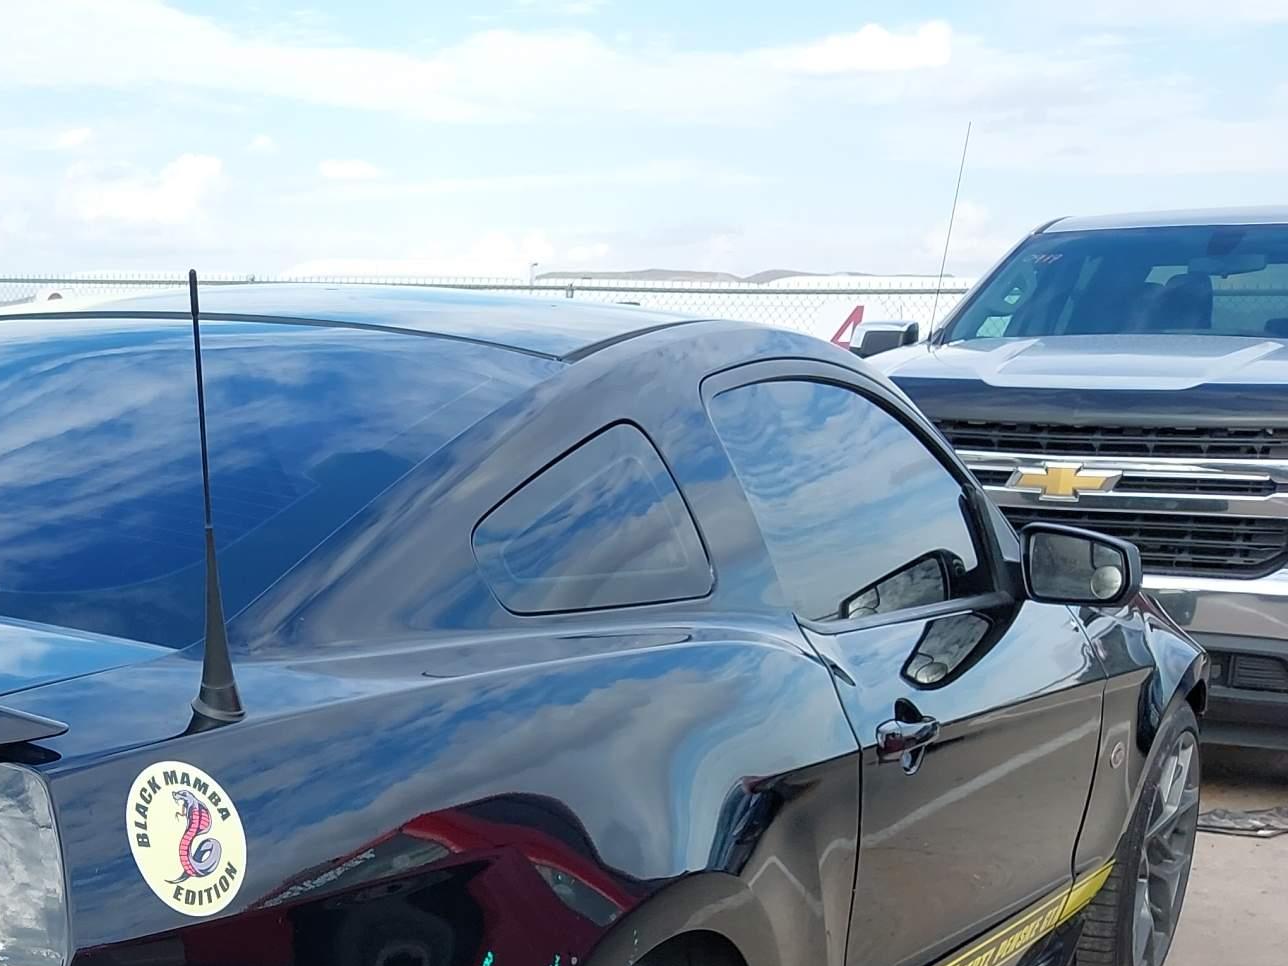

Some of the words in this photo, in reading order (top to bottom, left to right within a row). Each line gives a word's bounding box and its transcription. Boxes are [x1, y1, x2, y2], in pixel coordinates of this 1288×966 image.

[134, 776, 162, 848] BLACK
[162, 770, 231, 822] MAMBA
[172, 861, 238, 906] EDITION
